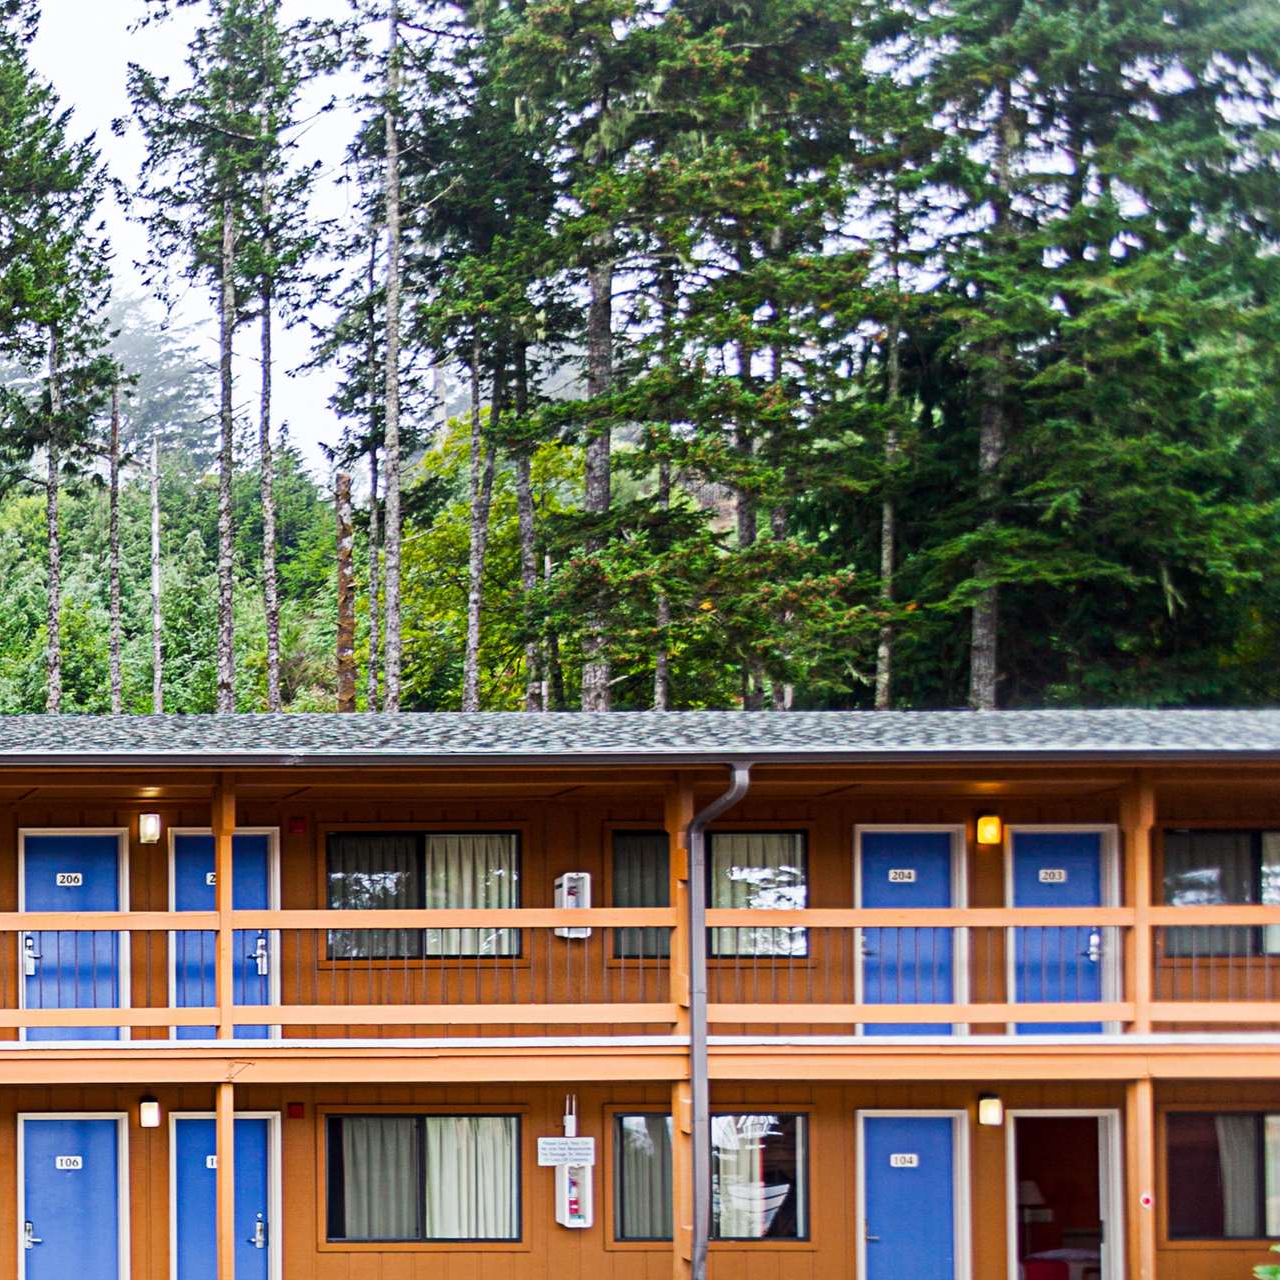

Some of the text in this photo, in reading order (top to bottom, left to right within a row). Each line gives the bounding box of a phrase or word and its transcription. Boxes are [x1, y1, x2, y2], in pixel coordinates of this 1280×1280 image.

[59, 874, 80, 885] 206
[891, 871, 912, 882] 204
[59, 1158, 79, 1168] 106
[893, 1156, 913, 1166] 104
